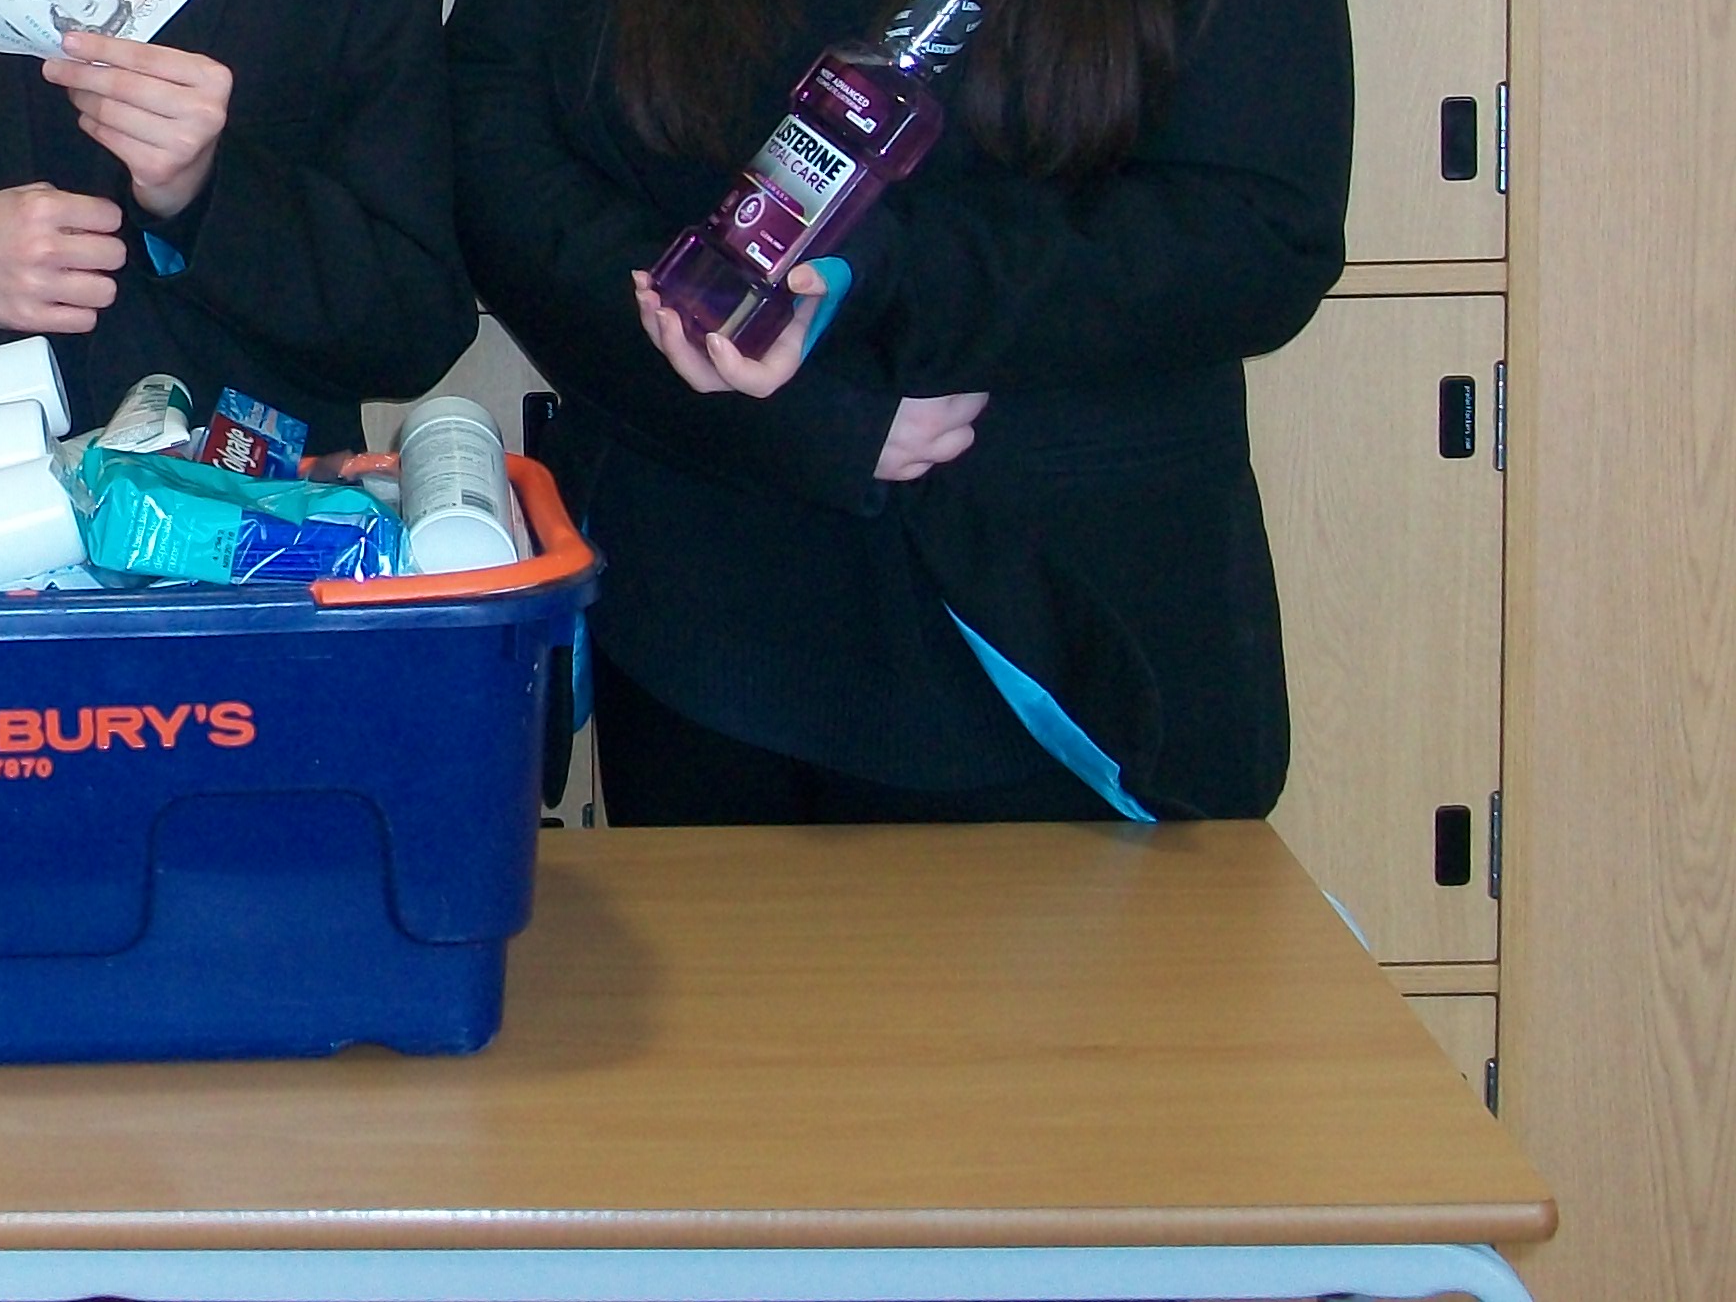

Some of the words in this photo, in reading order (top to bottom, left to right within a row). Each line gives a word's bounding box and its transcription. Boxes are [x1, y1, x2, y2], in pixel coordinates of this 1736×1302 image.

[774, 122, 847, 182] LISTERINE
[790, 155, 831, 195] CARE
[746, 200, 758, 215] 6
